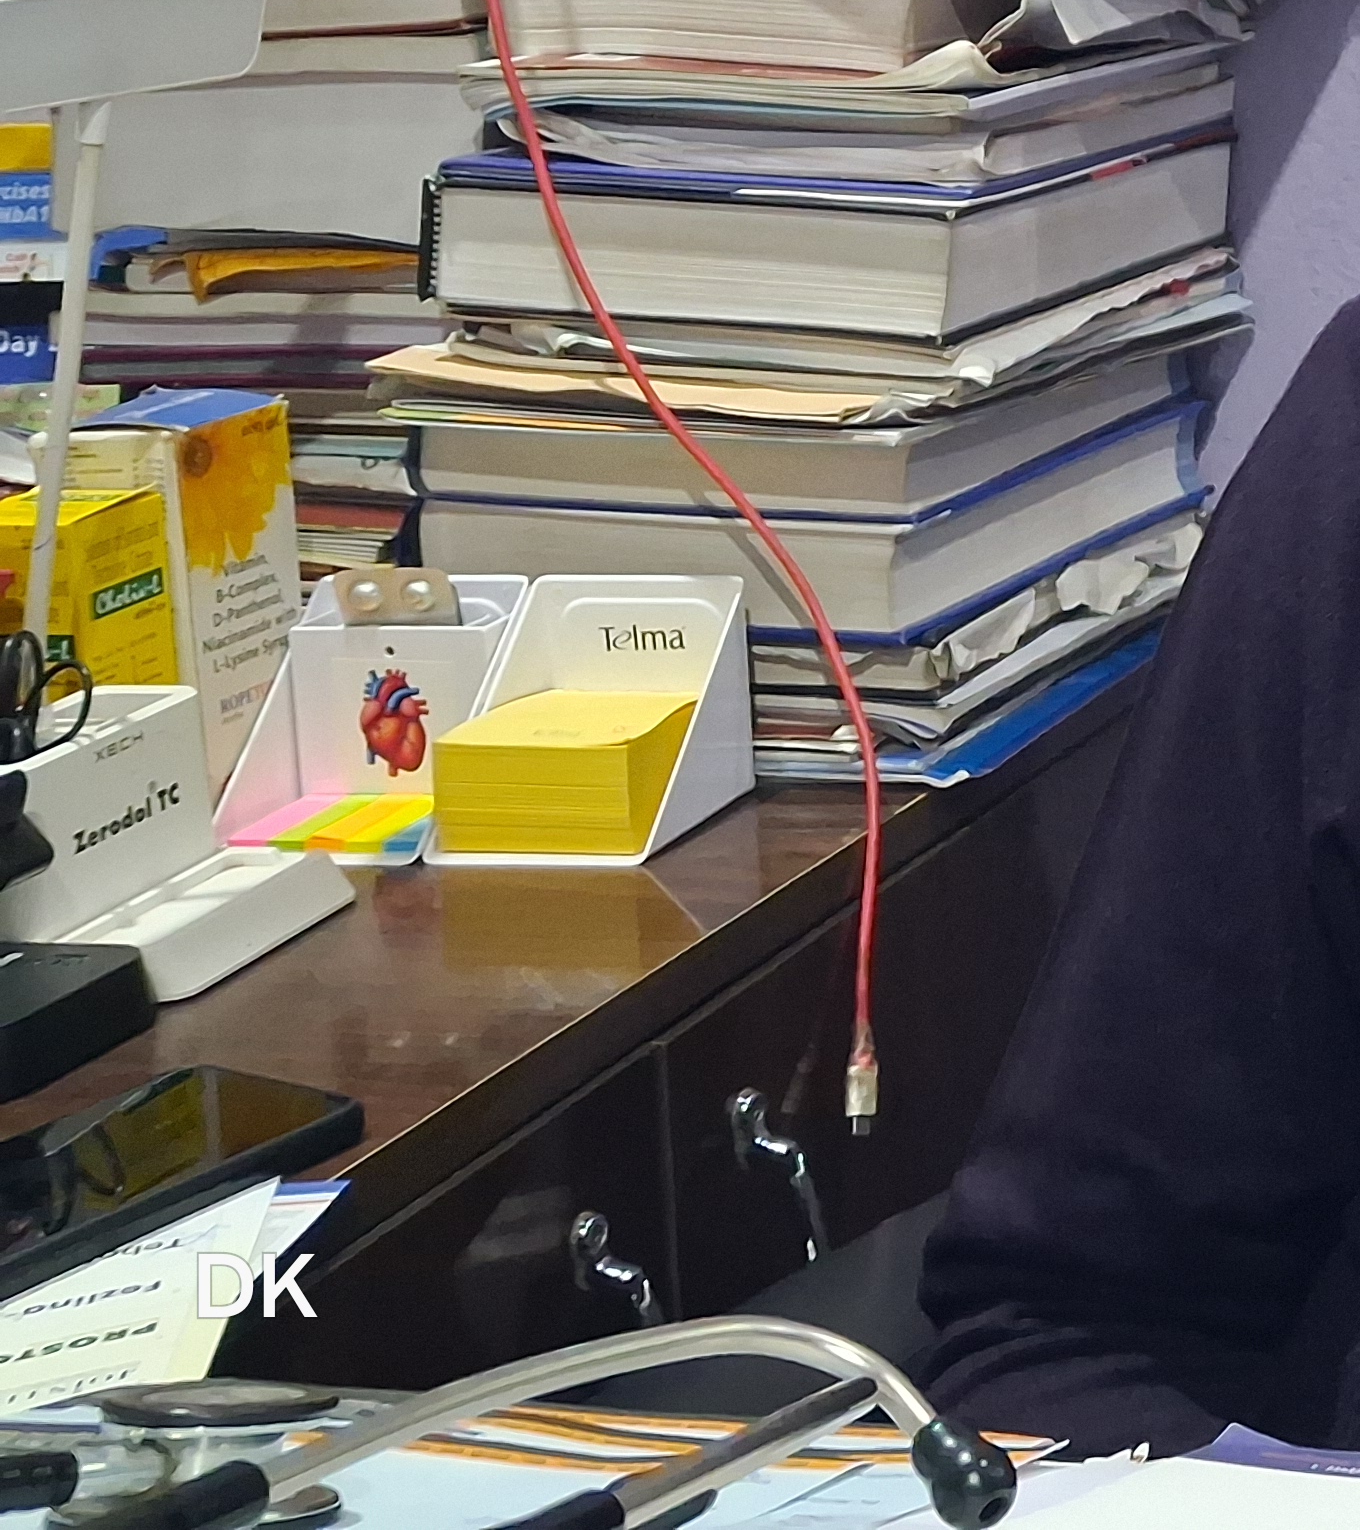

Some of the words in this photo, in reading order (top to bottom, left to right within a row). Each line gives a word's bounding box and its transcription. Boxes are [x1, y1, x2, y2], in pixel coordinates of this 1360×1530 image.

[599, 624, 686, 652] Telma
[94, 730, 144, 763] XECH
[73, 796, 153, 856] Zerodol
[157, 781, 180, 812] TC
